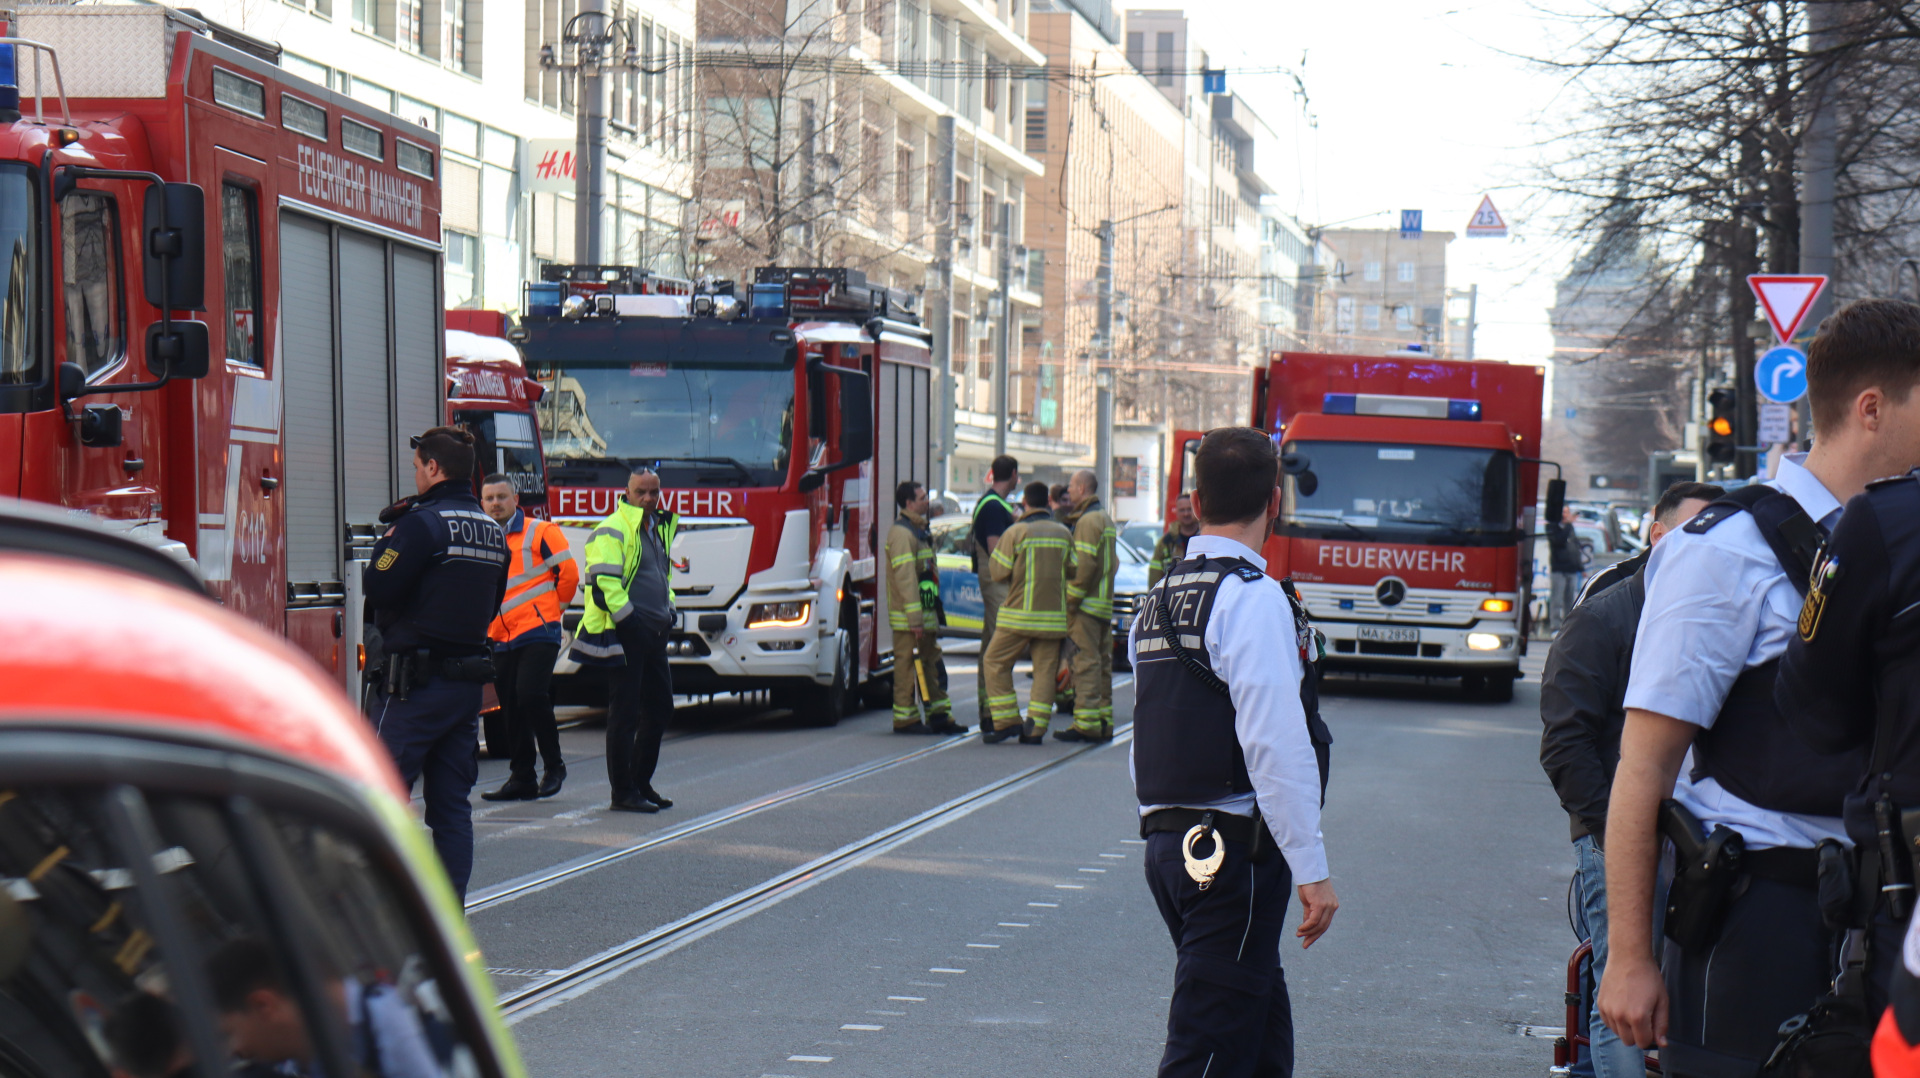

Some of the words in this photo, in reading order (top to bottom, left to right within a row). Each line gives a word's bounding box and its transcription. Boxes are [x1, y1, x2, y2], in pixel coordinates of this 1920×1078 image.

[536, 149, 577, 180] H&M
[297, 143, 366, 213] FEUERWEHR
[369, 169, 422, 231] MANNHEIM
[1402, 211, 1421, 229] W
[559, 489, 733, 515] FEUEWEHR
[249, 512, 266, 564] 112
[1318, 545, 1466, 573] FEUERWEHR
[1361, 629, 1378, 639] MA
[1387, 630, 1415, 641] 2858
